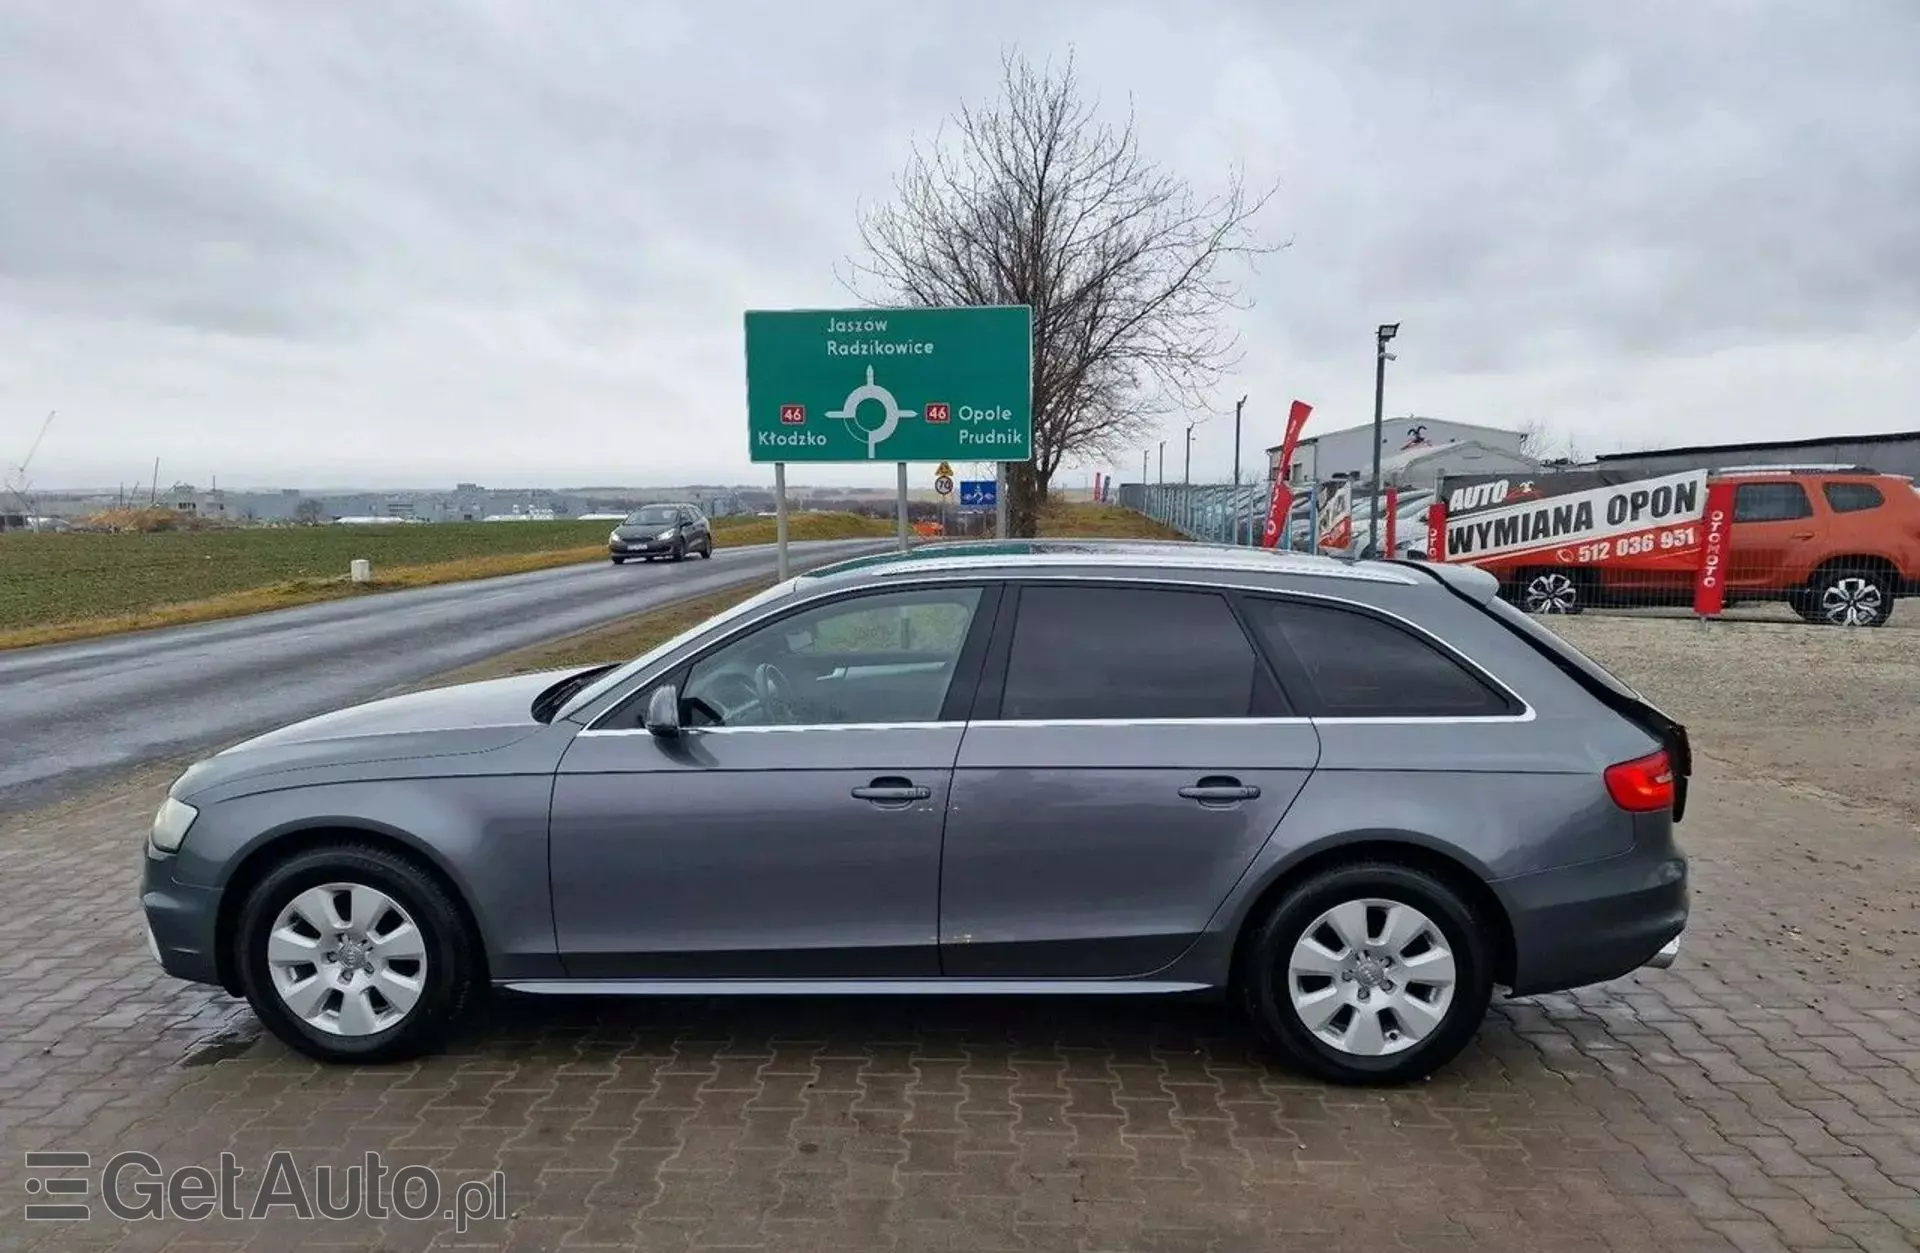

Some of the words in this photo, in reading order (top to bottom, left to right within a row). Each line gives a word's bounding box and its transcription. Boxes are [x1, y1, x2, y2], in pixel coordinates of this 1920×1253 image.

[827, 317, 888, 333] Jaszów
[827, 340, 935, 356] Radzikowice
[784, 408, 802, 421] 46
[928, 407, 947, 420] 46
[958, 405, 1013, 424] Opole
[758, 431, 827, 446] Kłodzko
[958, 429, 1023, 445] Prudnik
[1449, 480, 1509, 512] AUTO
[1448, 501, 1594, 555] WYMIANA
[1606, 480, 1698, 526] OPON
[1429, 528, 1438, 560] OTO
[1578, 541, 1611, 562] 512
[1616, 533, 1655, 556] 036
[1660, 527, 1695, 549] 951
[1703, 510, 1724, 587] OTOMOTO
